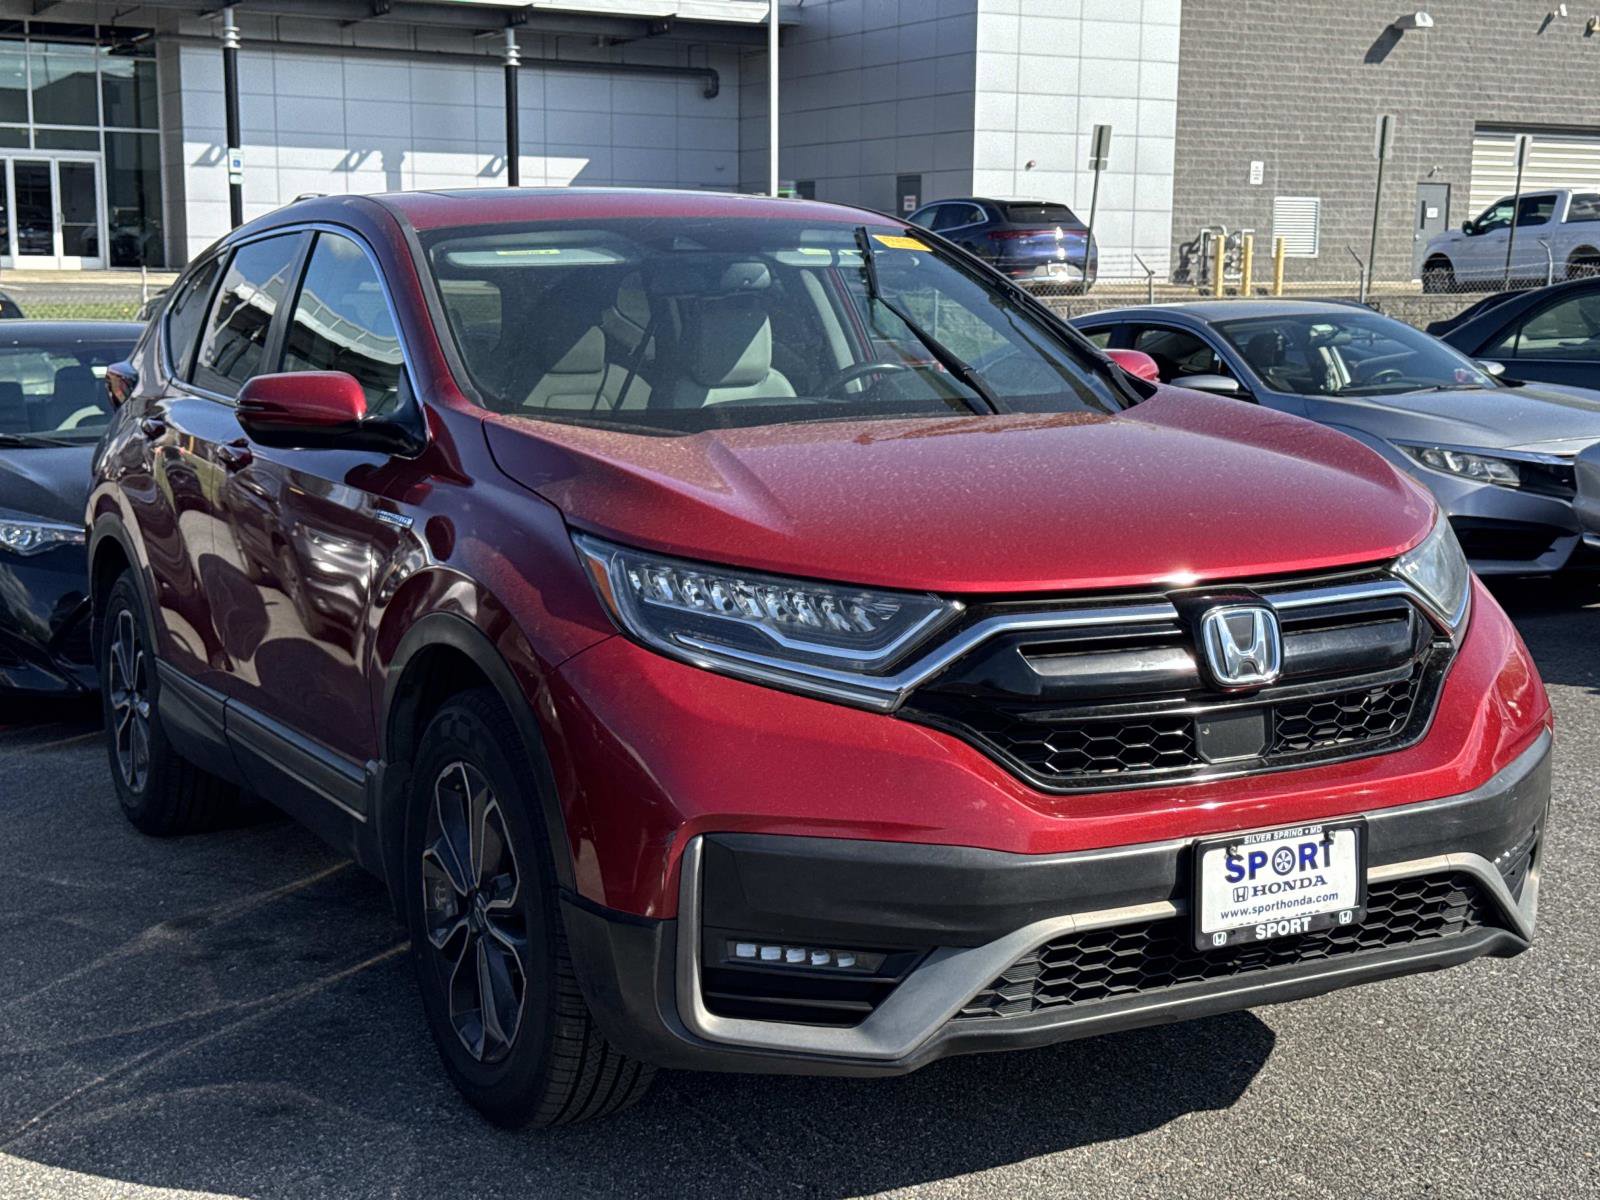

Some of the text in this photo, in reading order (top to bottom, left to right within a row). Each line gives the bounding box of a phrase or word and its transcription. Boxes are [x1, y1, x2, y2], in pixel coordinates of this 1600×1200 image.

[1244, 825, 1322, 845] SILVER SPRING MD
[1225, 840, 1334, 883] SPORT
[1252, 875, 1328, 897] HONDA
[1220, 892, 1339, 919] www.sporthonda.com
[1255, 917, 1312, 940] SPORT
